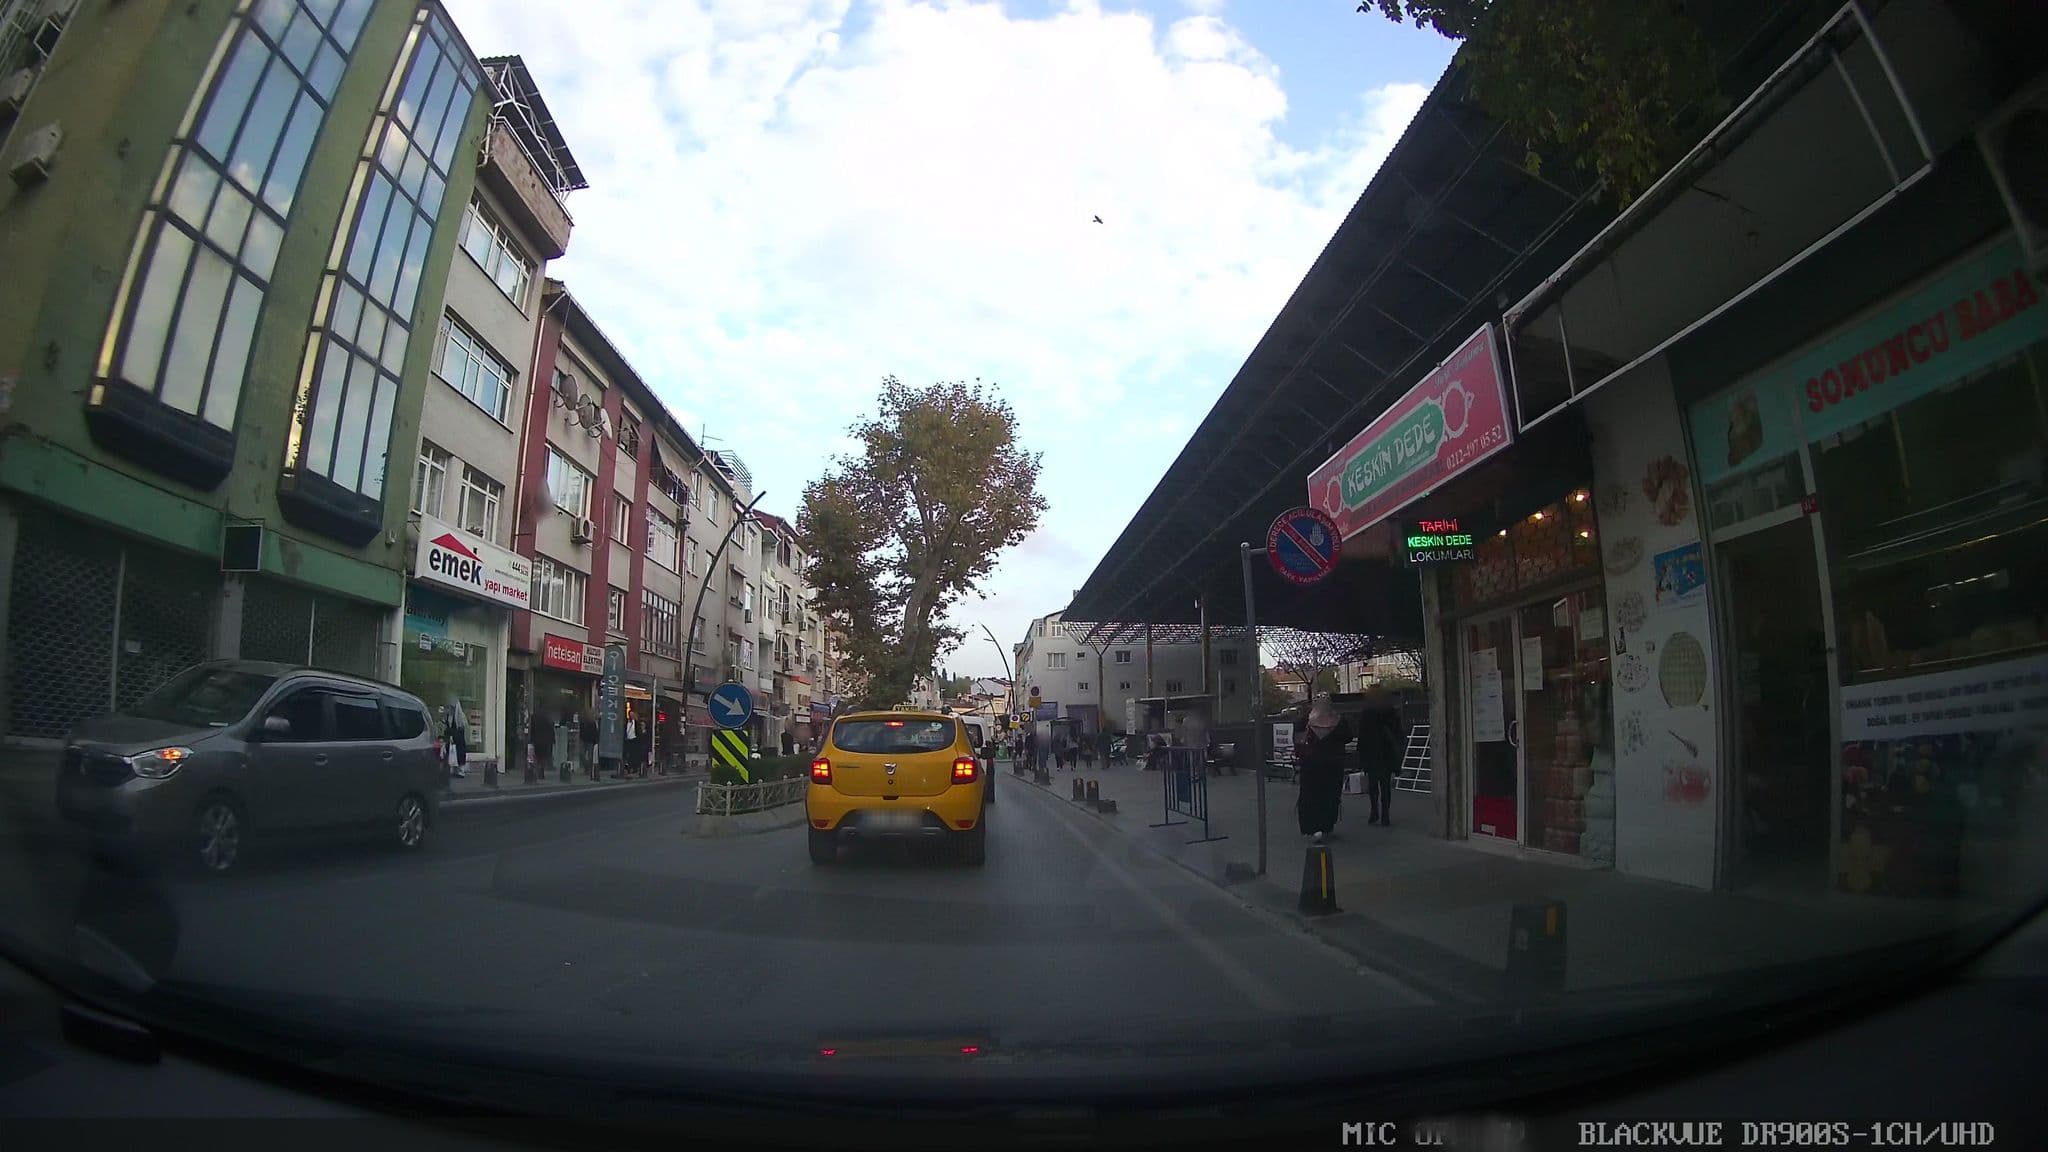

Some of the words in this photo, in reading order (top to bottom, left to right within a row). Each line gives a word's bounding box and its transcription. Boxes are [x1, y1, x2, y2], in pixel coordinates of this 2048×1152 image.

[1806, 310, 1949, 413] SOMUNCU
[1955, 267, 2040, 341] BABA
[1348, 444, 1394, 497] KESKİN
[1393, 413, 1437, 465] DEDE
[1418, 518, 1458, 533] TARİHİ
[1407, 533, 1444, 548] KESKİN
[1445, 534, 1473, 546] DEDE
[429, 547, 482, 586] emek
[1409, 549, 1474, 563] LOKUMLARI
[484, 579, 501, 594] yapı
[502, 585, 528, 602] market
